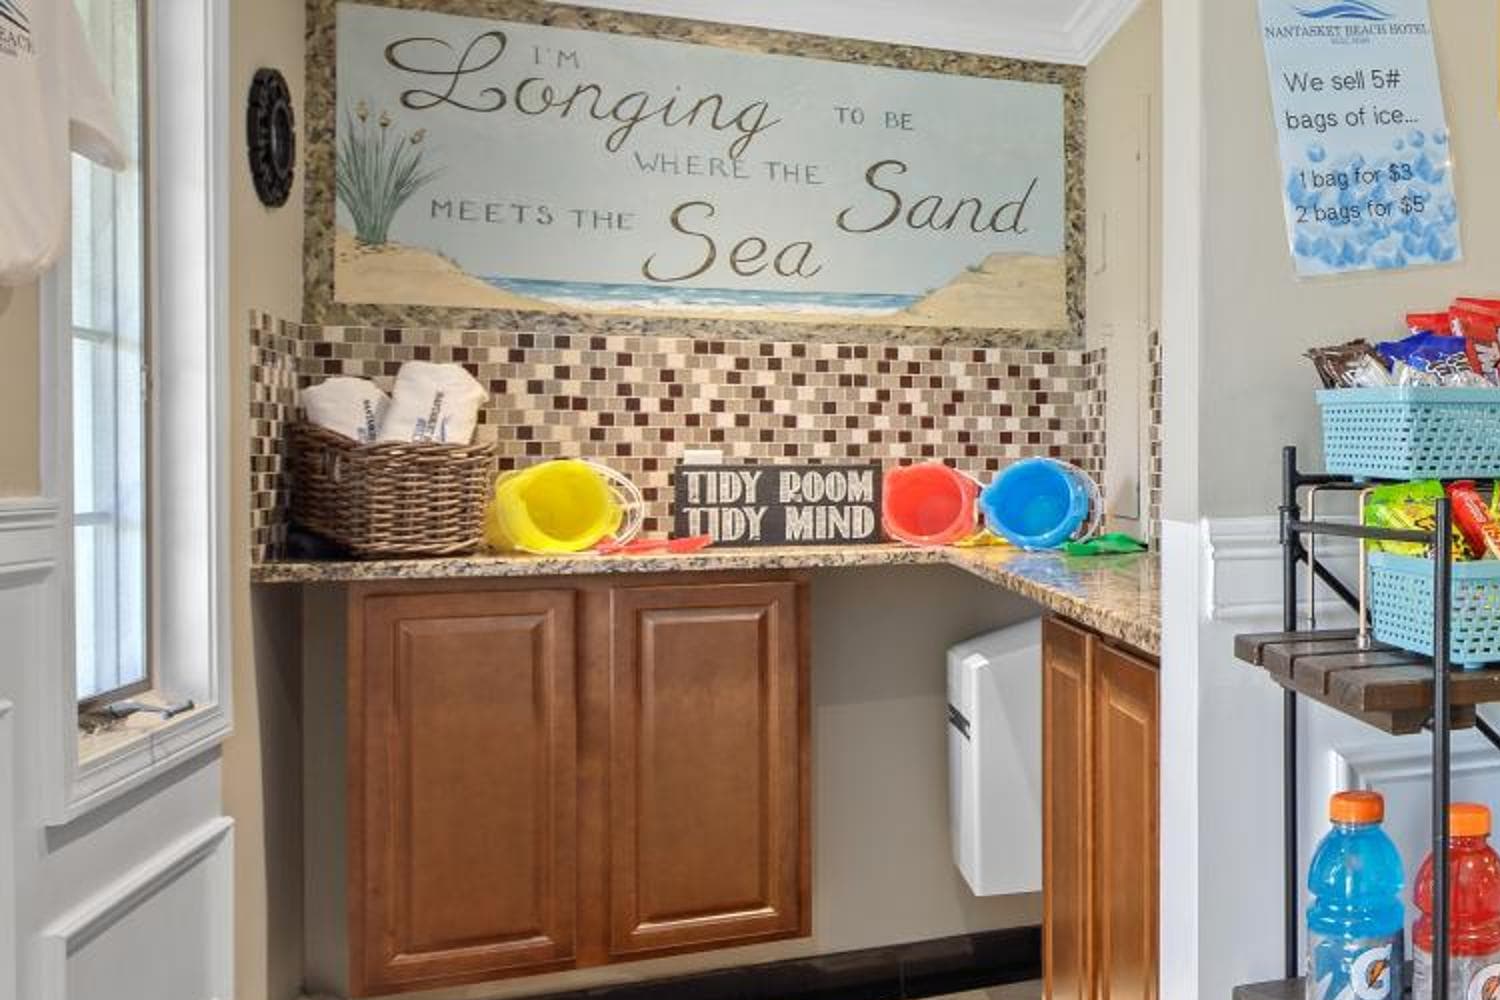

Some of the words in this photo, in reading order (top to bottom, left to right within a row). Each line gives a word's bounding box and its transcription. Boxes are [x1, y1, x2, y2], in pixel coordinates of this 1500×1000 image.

[534, 46, 581, 69] I'M
[384, 31, 782, 158] Longing
[834, 106, 865, 126] TO
[885, 111, 914, 131] BE
[1283, 71, 1324, 93] We
[1331, 70, 1366, 91] sell
[1371, 69, 1401, 90] 5#
[1286, 110, 1338, 133] bags
[1345, 106, 1366, 128] of
[1373, 105, 1420, 126] ice...
[634, 151, 750, 179] WHERE
[766, 160, 824, 185] THE
[1312, 169, 1349, 192] bag
[1354, 166, 1383, 184] for
[1388, 163, 1413, 184] $3
[836, 159, 1038, 235] Sand
[1295, 204, 1309, 224] 2
[1315, 203, 1361, 224] bags
[1367, 199, 1395, 218] for
[1400, 195, 1426, 217] $5
[431, 200, 553, 226] MEETS
[568, 208, 637, 231] THE
[642, 201, 826, 283] Sea
[682, 470, 764, 504] TIDY
[778, 469, 874, 503] ROOM
[682, 506, 769, 541] TIDY
[785, 505, 875, 541] MIND
